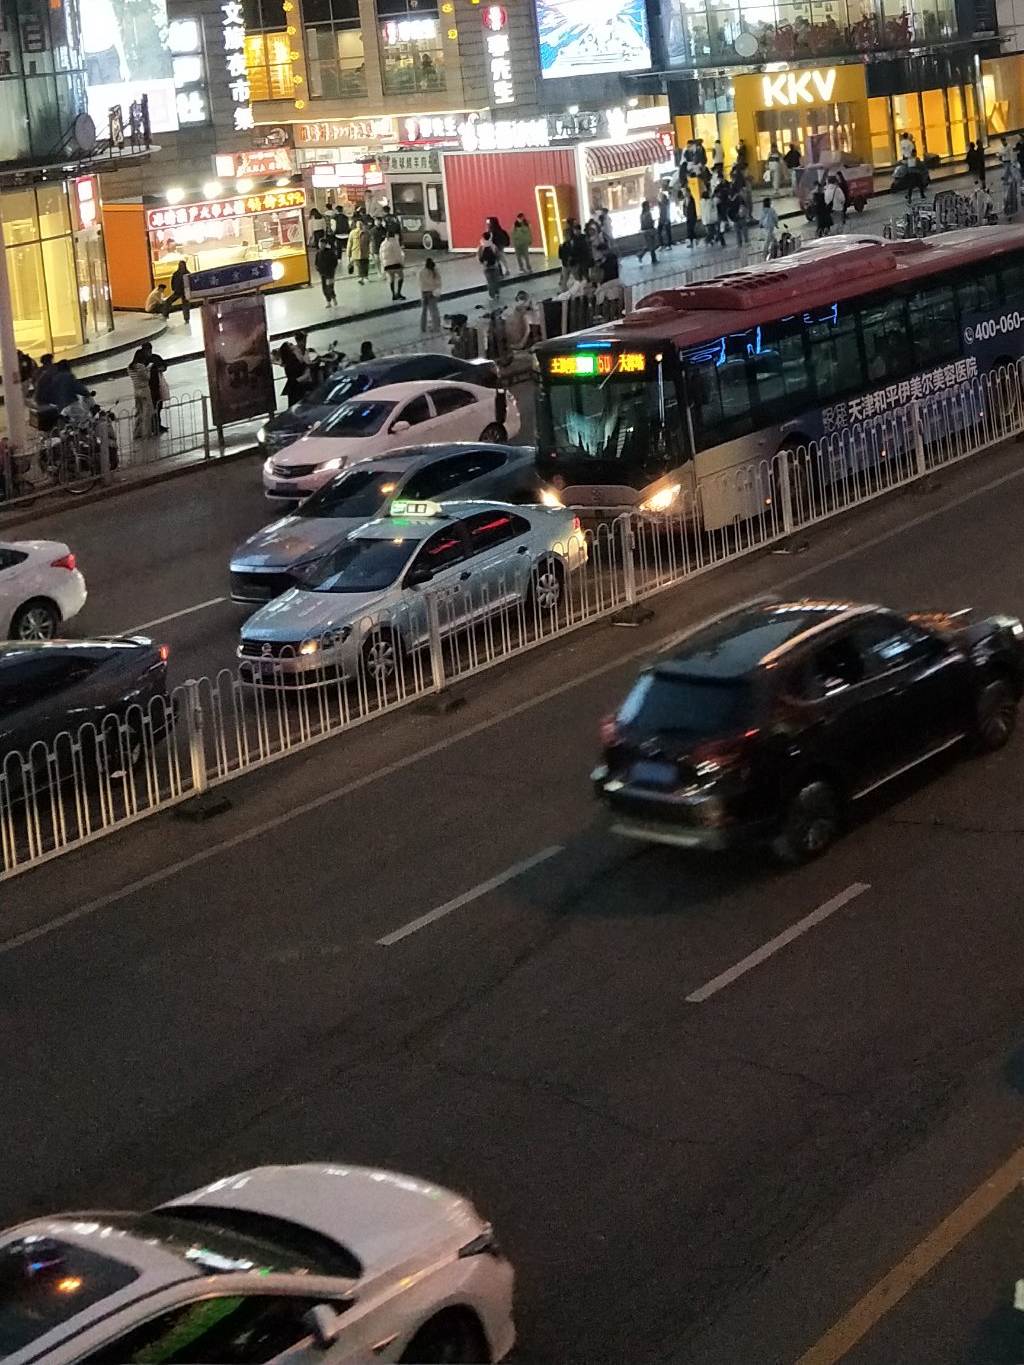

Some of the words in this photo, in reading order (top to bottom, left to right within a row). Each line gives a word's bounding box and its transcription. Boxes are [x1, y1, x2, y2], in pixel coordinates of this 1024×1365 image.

[762, 68, 837, 108] KKV
[848, 355, 979, 424] 天津和平伊美尔美容医院
